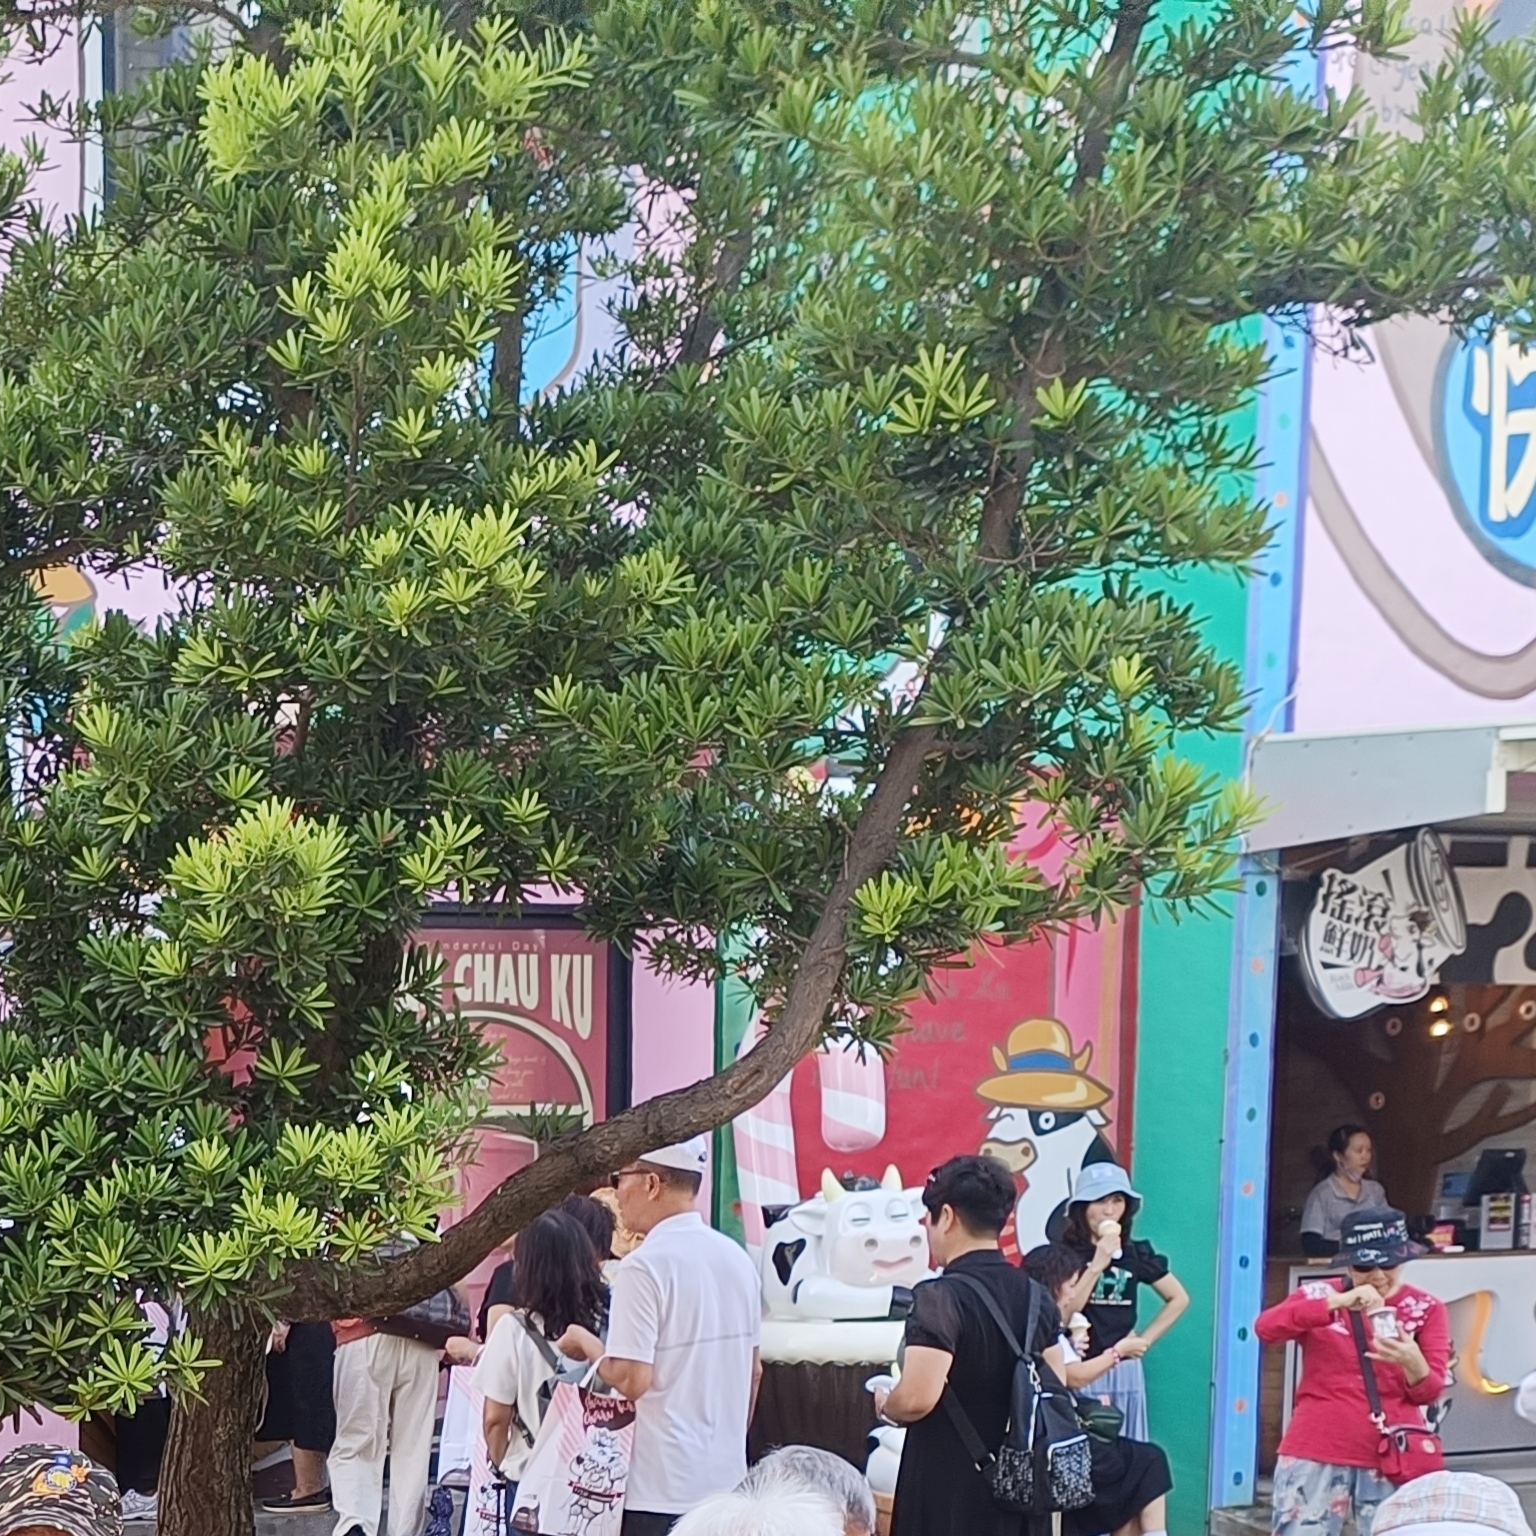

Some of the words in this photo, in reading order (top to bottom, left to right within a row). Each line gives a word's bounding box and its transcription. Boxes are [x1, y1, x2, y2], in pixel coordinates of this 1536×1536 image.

[512, 941, 539, 953] Day
[453, 953, 540, 1011] CHAU
[550, 953, 594, 1041] KU
